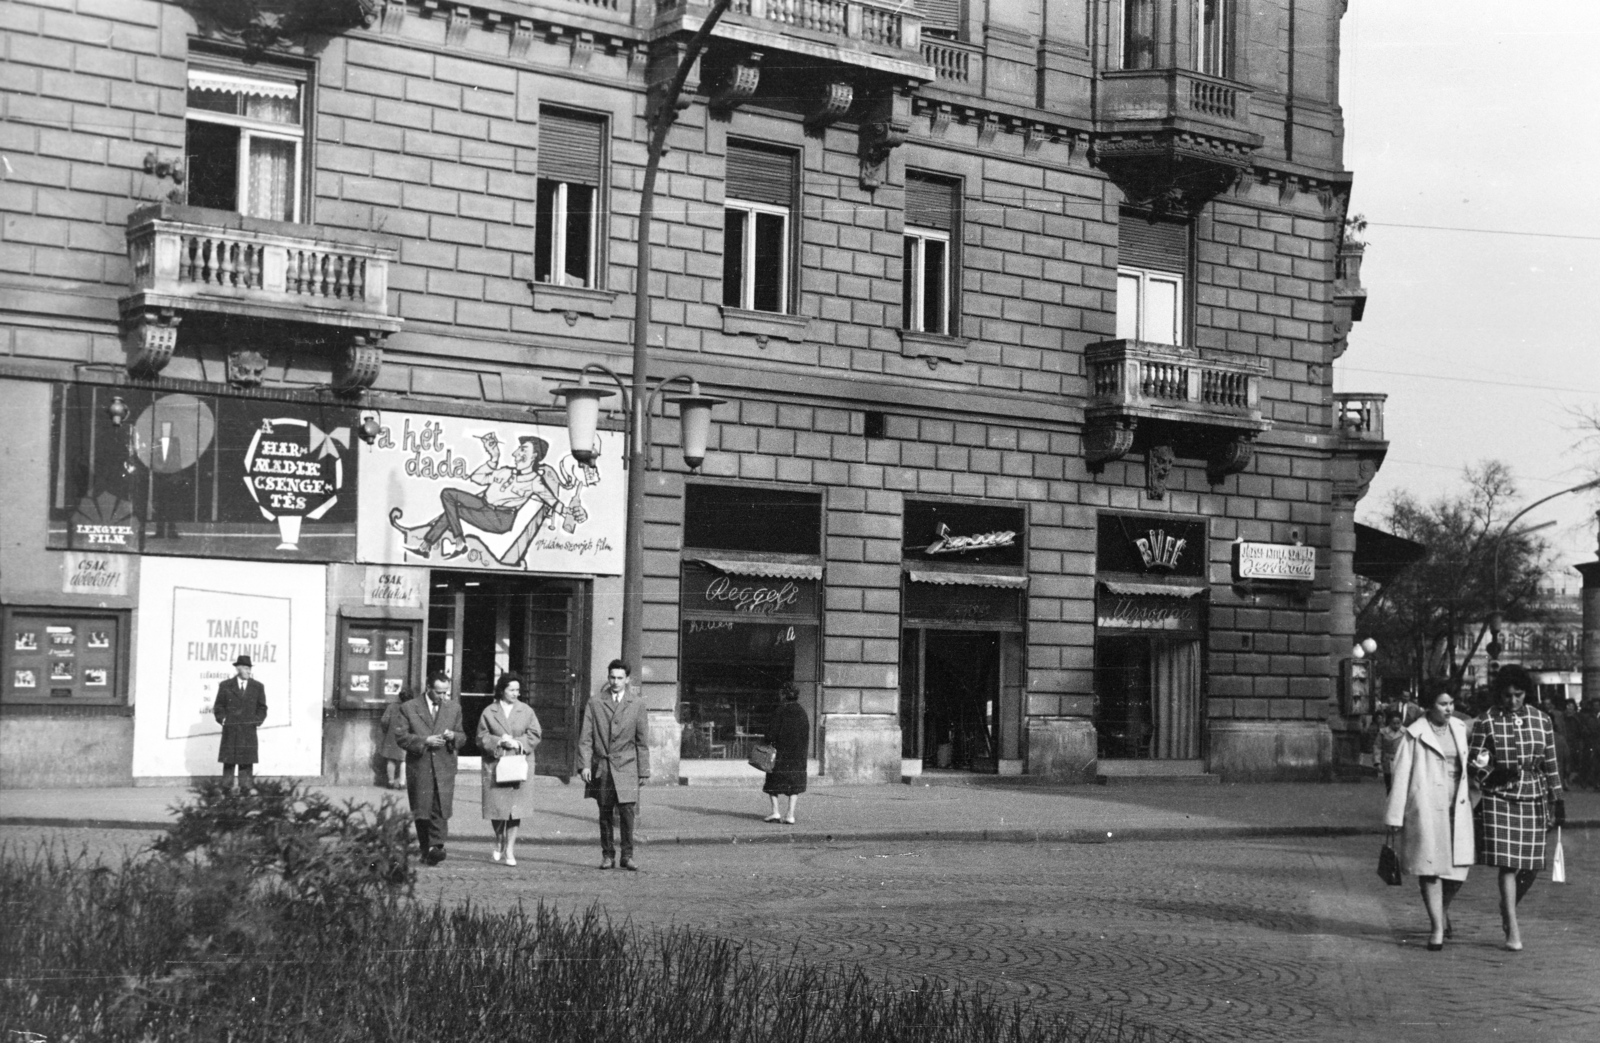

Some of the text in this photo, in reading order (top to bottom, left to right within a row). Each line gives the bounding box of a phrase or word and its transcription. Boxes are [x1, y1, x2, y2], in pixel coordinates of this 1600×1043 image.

[261, 418, 274, 434] A
[377, 418, 445, 453] a hét
[253, 458, 321, 476] MADIK
[404, 448, 471, 480] dada
[270, 492, 307, 509] TÉS
[76, 524, 134, 535] LENGYEL
[88, 534, 127, 545] FILM
[78, 559, 109, 571] CSAK
[379, 574, 404, 585] CSAK
[705, 576, 799, 611] Reggeli
[206, 616, 259, 639] TANÁCS
